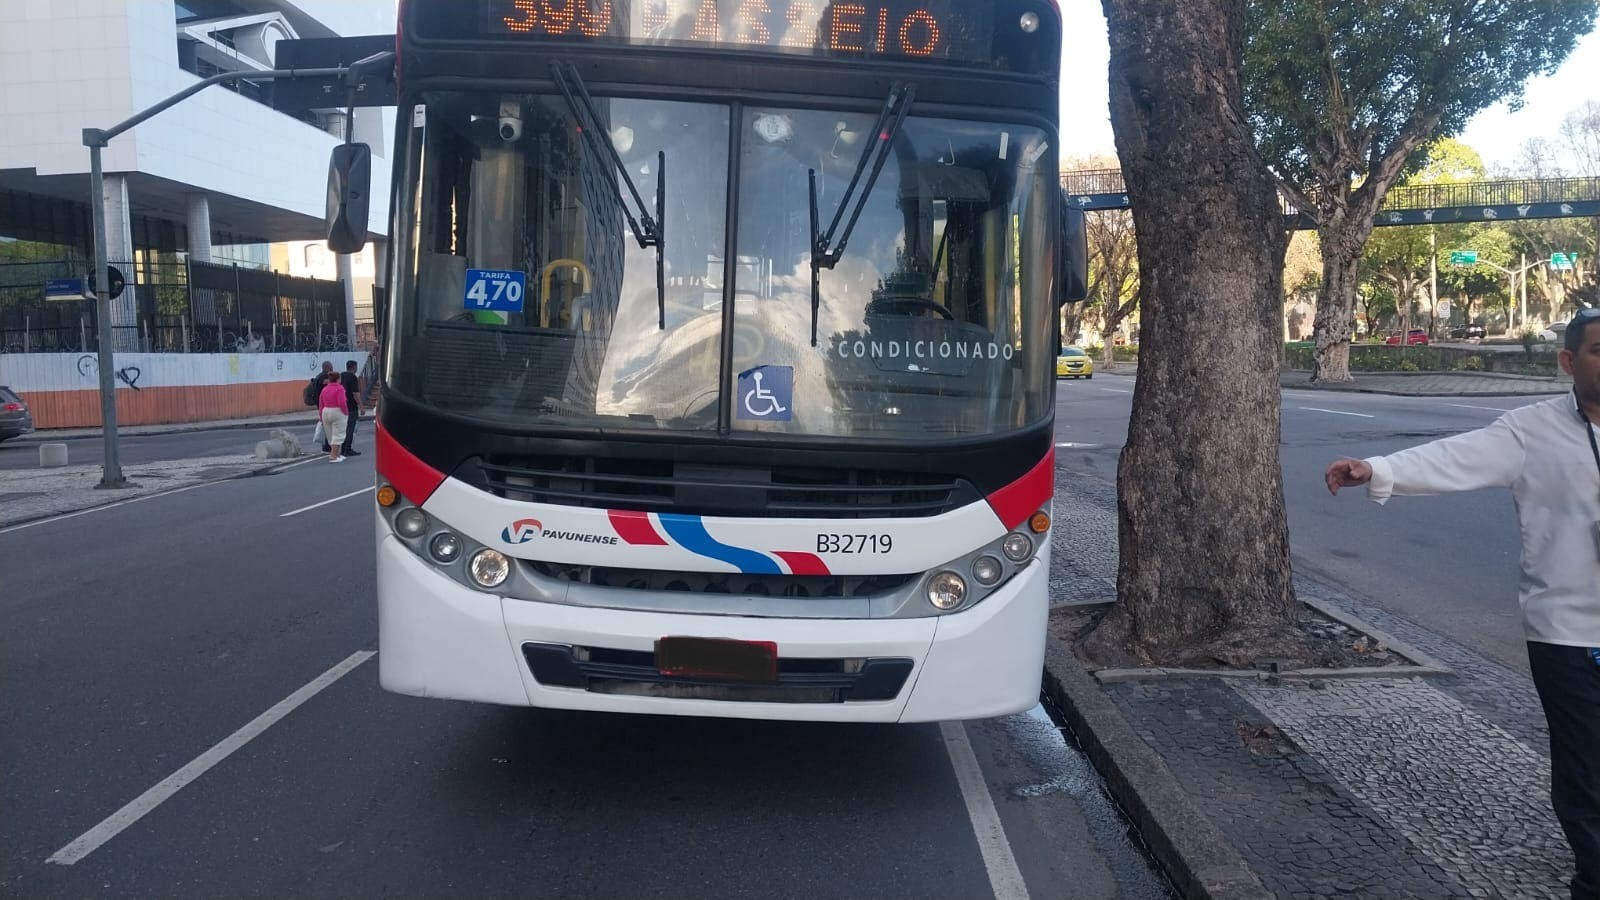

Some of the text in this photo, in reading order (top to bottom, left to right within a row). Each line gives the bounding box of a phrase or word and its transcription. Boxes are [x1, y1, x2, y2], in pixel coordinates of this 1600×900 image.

[503, 0, 940, 54] 399 PASSEIO
[479, 271, 511, 279] TARIFA
[466, 279, 522, 308] 4,70
[838, 340, 1014, 361] CONDICIONADO
[542, 529, 619, 546] PAVUNENSE
[816, 533, 893, 554] B32719
